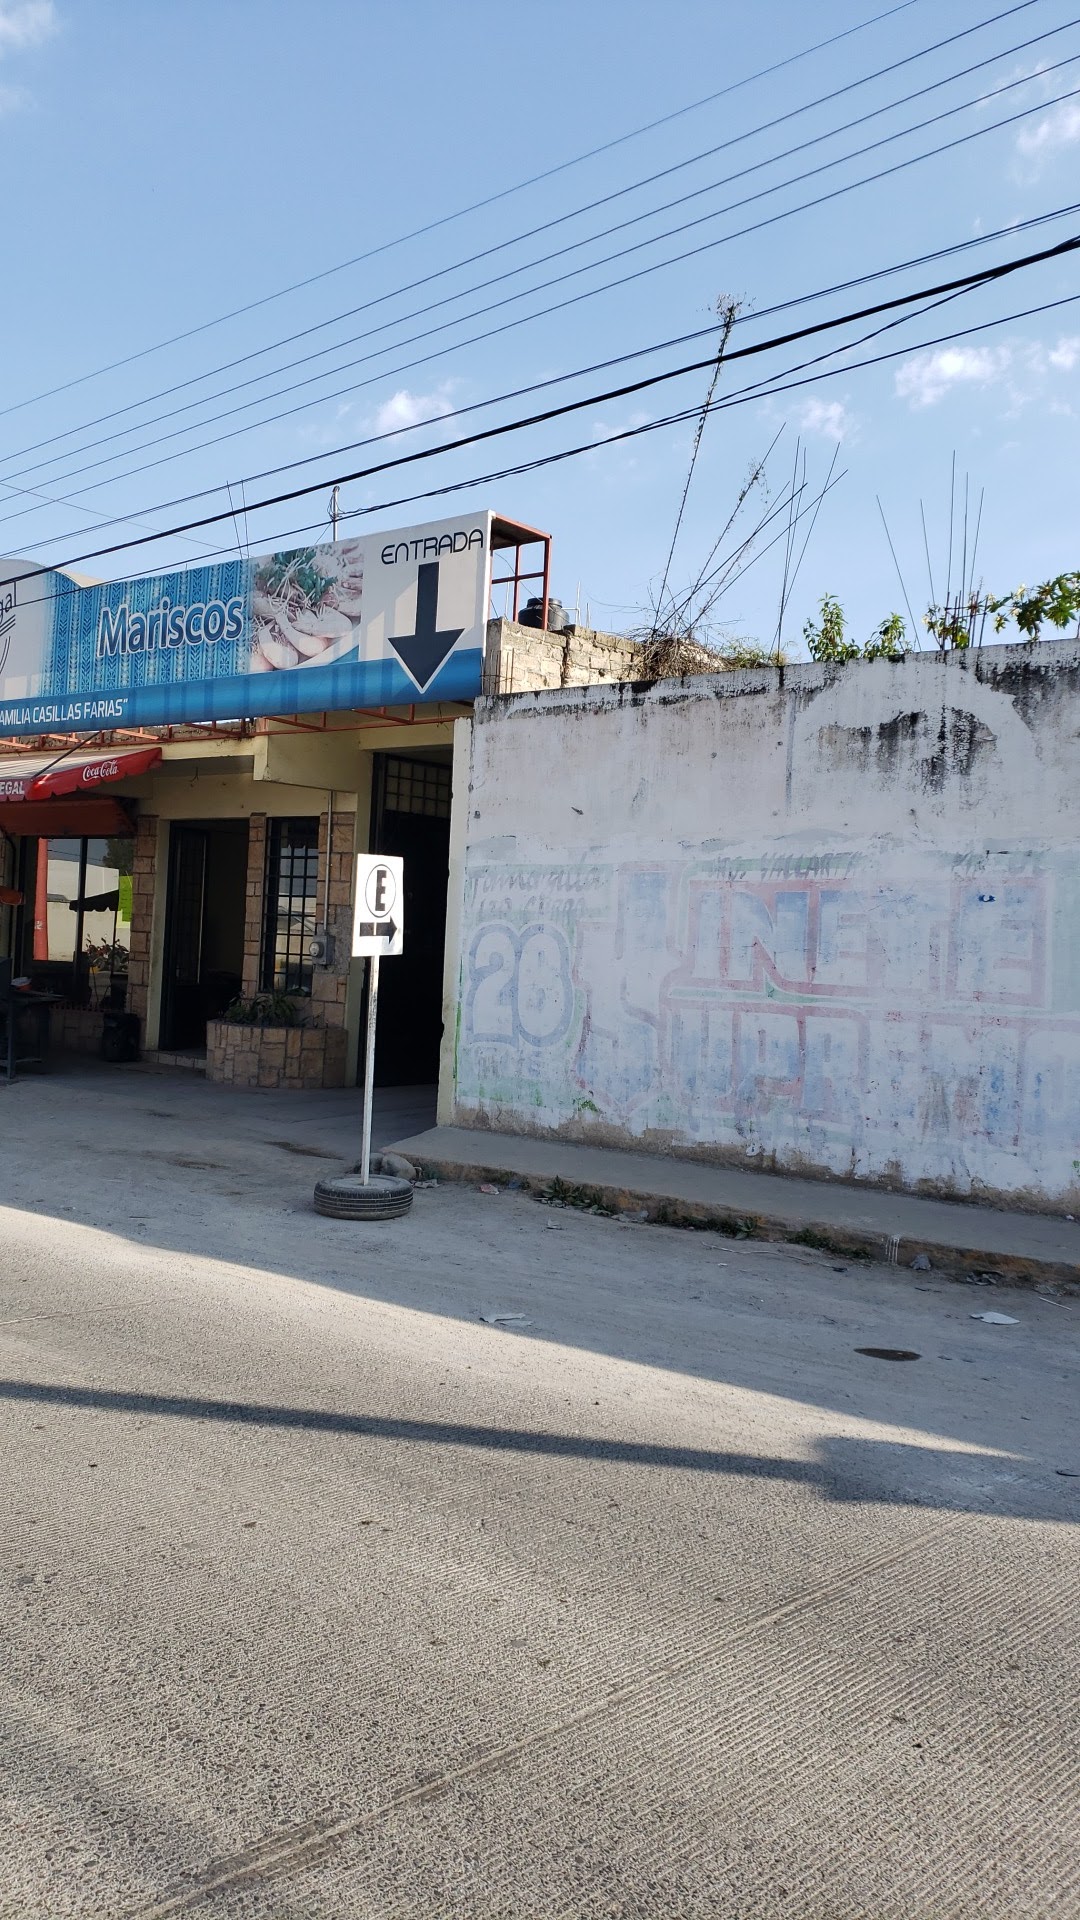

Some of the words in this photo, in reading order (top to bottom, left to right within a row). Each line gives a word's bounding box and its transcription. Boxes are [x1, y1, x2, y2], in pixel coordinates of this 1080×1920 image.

[381, 528, 484, 565] ENTRADA
[97, 597, 243, 658] Mariscos
[33, 702, 82, 724] CASILLAS
[375, 869, 387, 911] E
[466, 922, 574, 1048] 20
